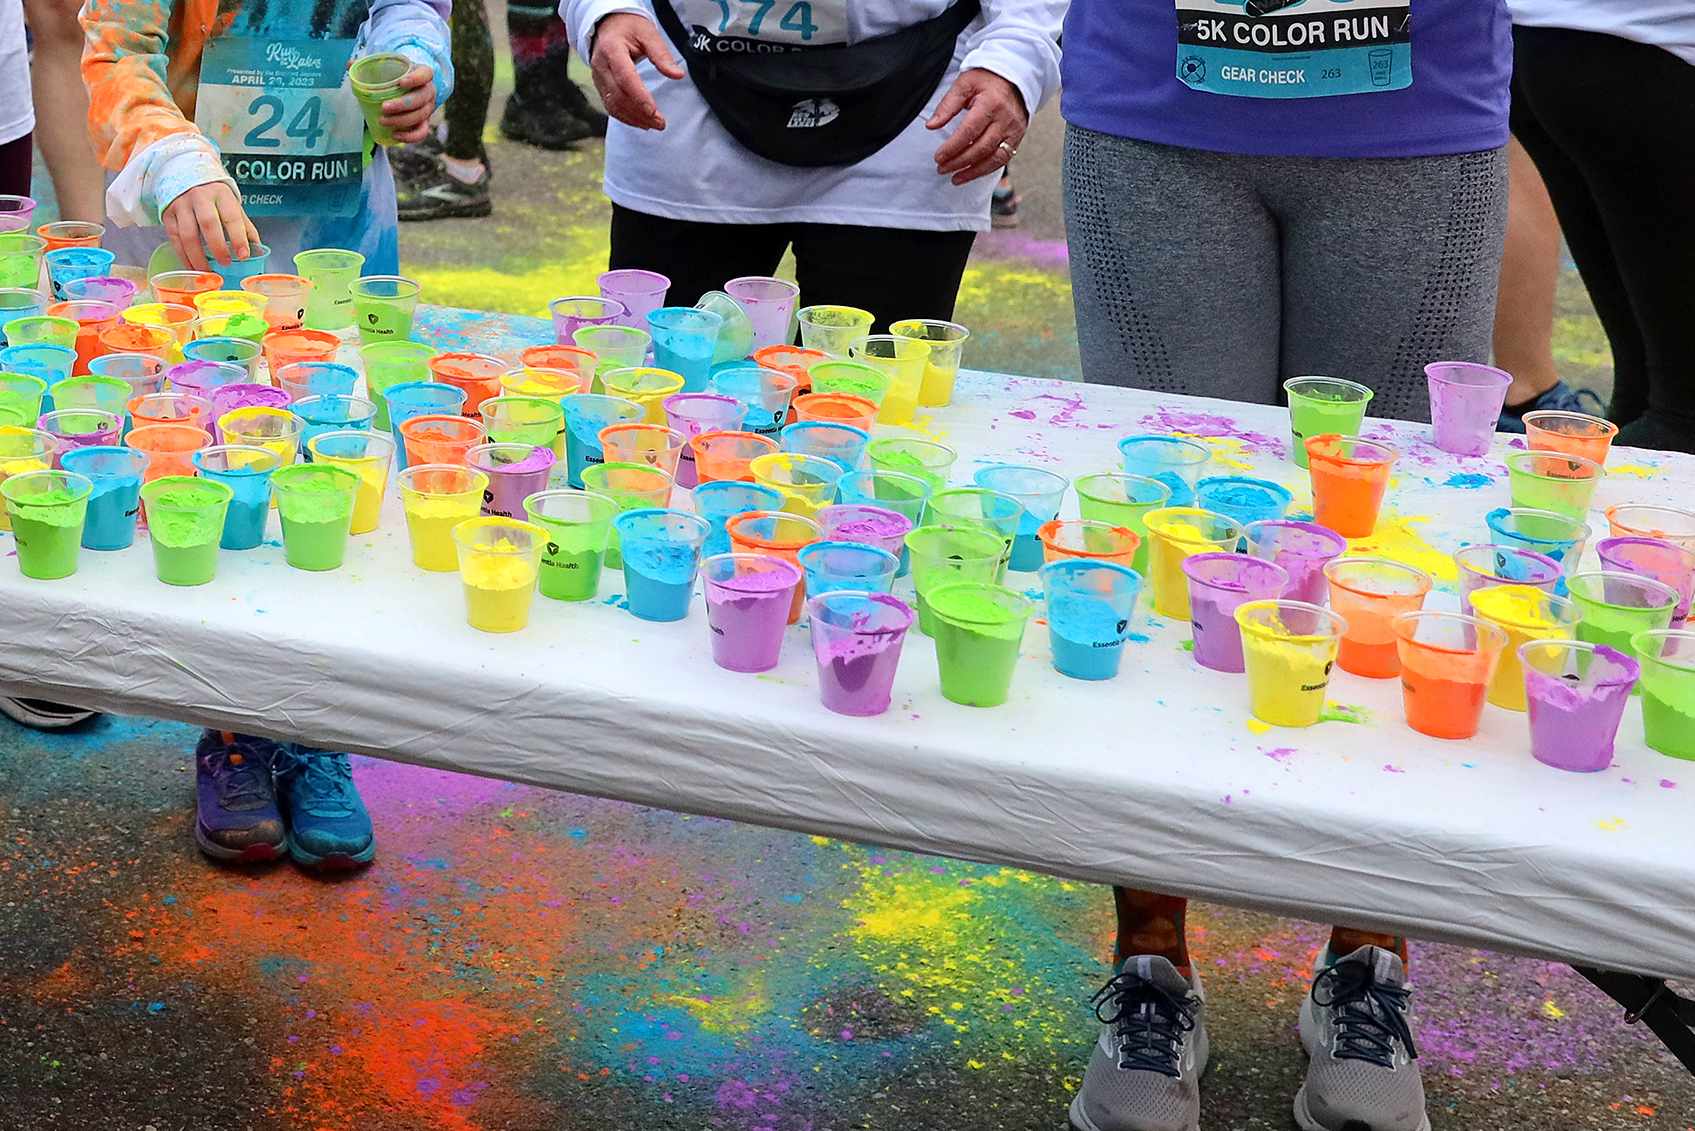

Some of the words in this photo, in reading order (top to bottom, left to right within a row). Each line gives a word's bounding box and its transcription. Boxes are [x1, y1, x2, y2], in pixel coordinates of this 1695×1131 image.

[1197, 19, 1229, 43] 5K
[1233, 21, 1326, 47] COLOR
[1334, 15, 1390, 42] RUN
[266, 42, 298, 62] Run
[1373, 59, 1389, 70] 263
[231, 75, 266, 85] APRIL
[1221, 65, 1256, 82] GEAR
[1259, 69, 1306, 85] CHECK
[1321, 68, 1342, 79] 263
[244, 94, 323, 149] 24
[235, 160, 306, 181] COLOR
[311, 159, 348, 180] RUN
[249, 194, 283, 205] CHECK
[491, 509, 513, 518] Health
[555, 560, 579, 570] Health
